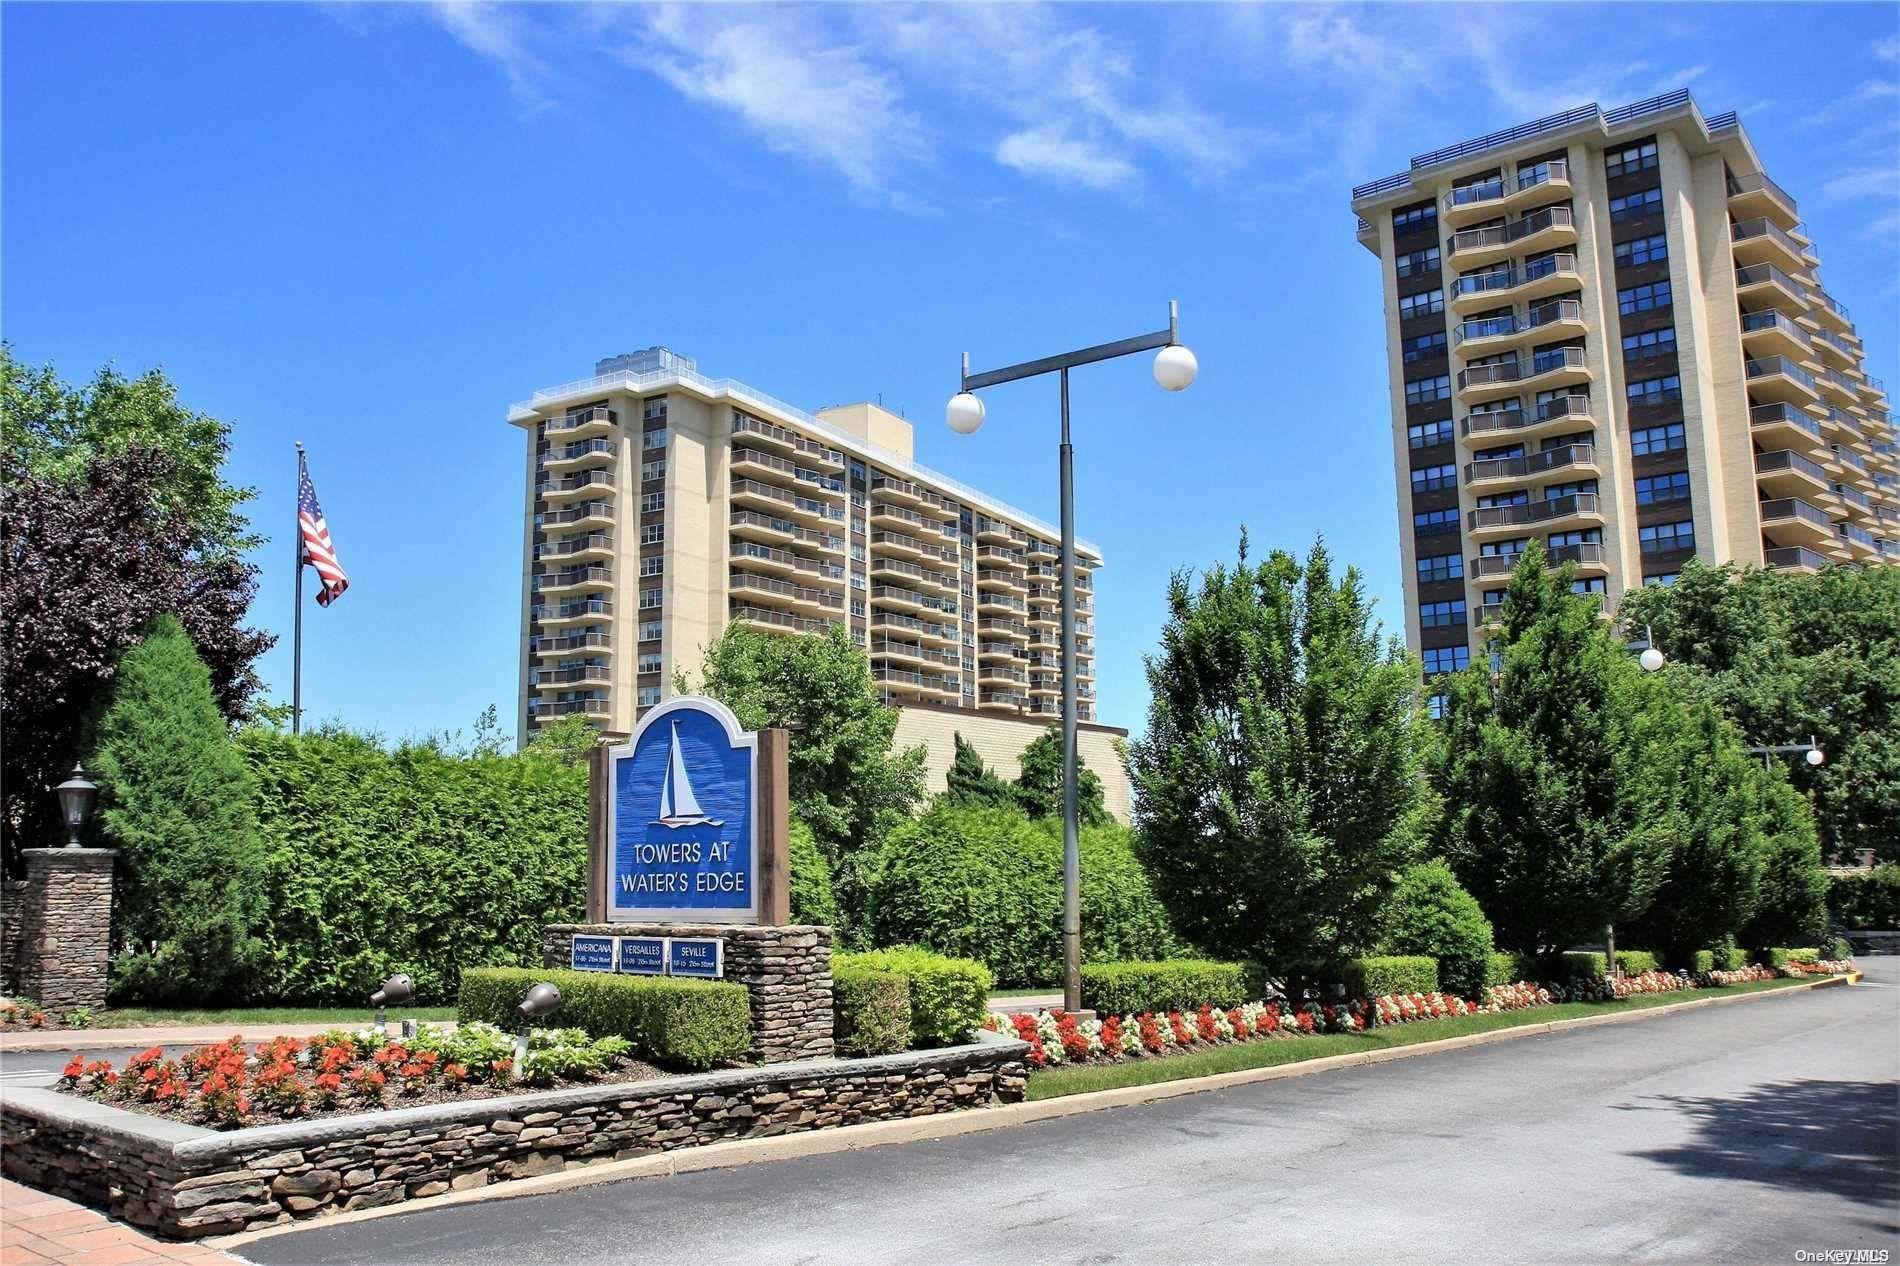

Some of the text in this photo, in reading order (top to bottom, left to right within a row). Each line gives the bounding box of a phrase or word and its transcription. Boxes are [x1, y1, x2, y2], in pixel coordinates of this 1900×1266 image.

[634, 841, 730, 864] TOWERS AT
[621, 872, 745, 892] WATER'S EDGE
[575, 943, 611, 953] AMERICANA
[624, 945, 660, 956] VERSAILLES
[681, 946, 707, 957] SEVILLE
